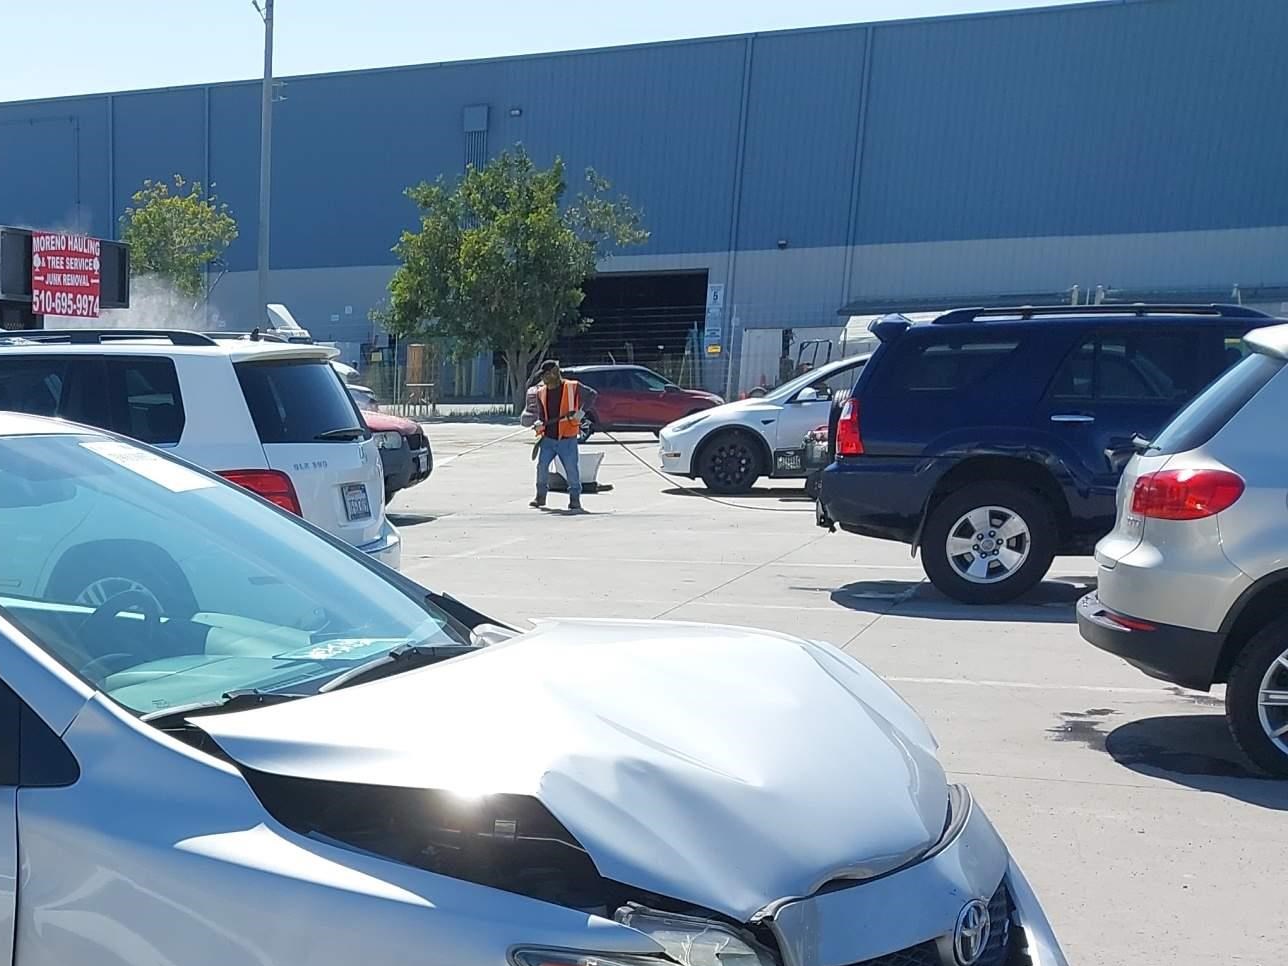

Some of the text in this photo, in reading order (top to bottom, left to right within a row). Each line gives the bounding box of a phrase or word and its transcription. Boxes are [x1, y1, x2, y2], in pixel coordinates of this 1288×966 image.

[32, 235, 100, 256] MORENO HAULING
[47, 256, 65, 269] TREE
[65, 257, 93, 271] SERVICE
[45, 273, 90, 286] JUNK REMOVAL
[32, 289, 100, 316] 510-695-9974
[712, 291, 719, 301] 5
